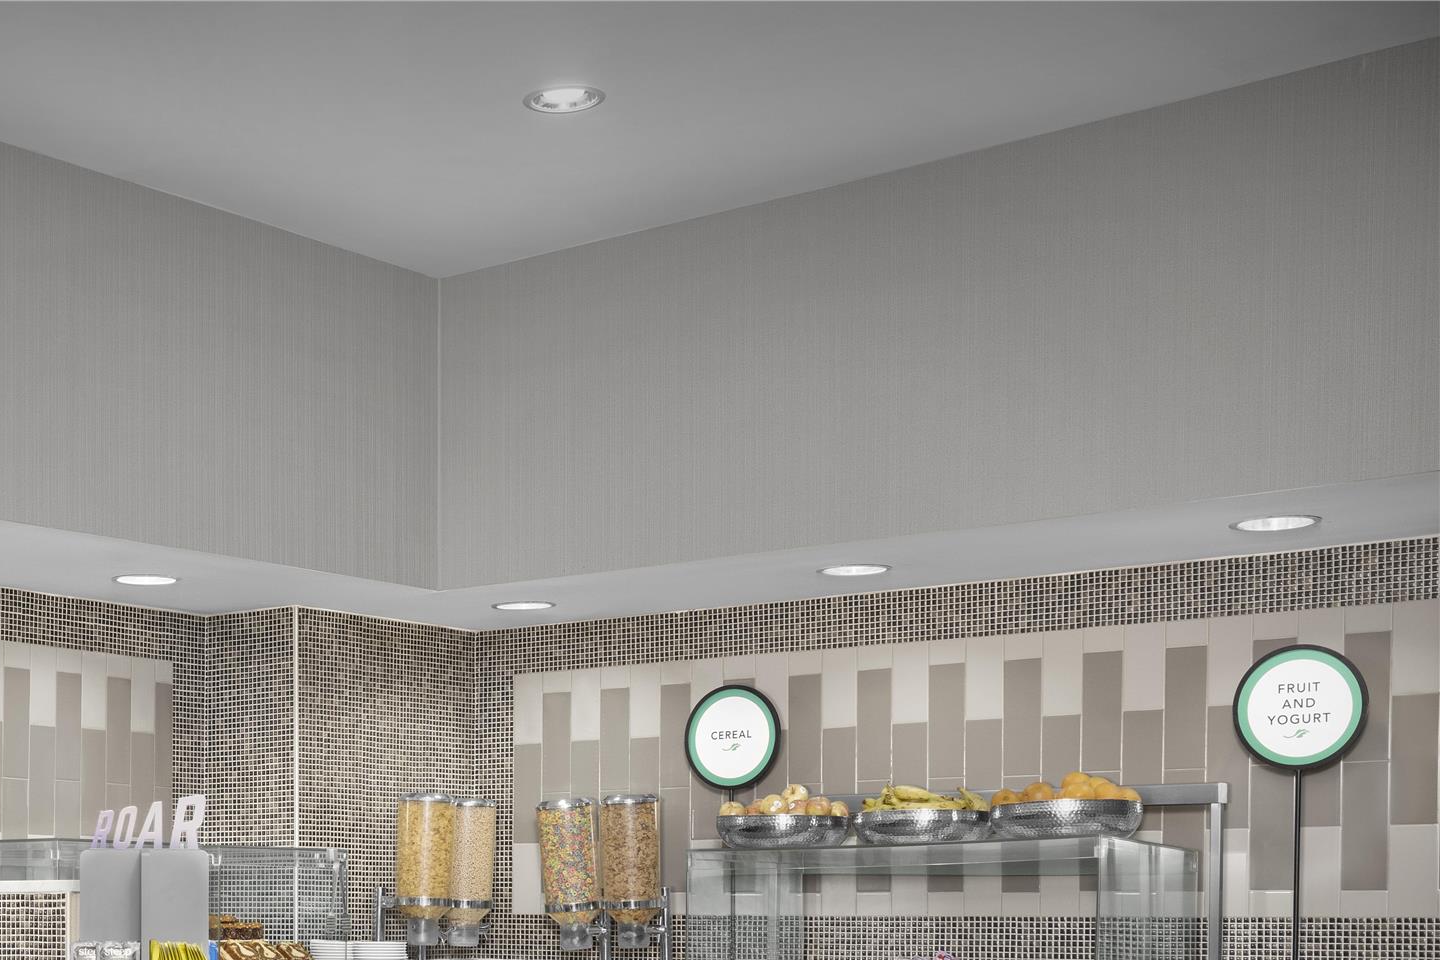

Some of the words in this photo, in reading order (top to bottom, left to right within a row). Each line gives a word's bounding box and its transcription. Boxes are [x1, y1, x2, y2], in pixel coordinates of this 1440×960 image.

[1278, 681, 1321, 694] FRUIT
[1282, 697, 1316, 709] AND
[1267, 712, 1331, 725] YOGURT
[710, 730, 752, 740] CEREAL
[90, 793, 207, 849] ROAR
